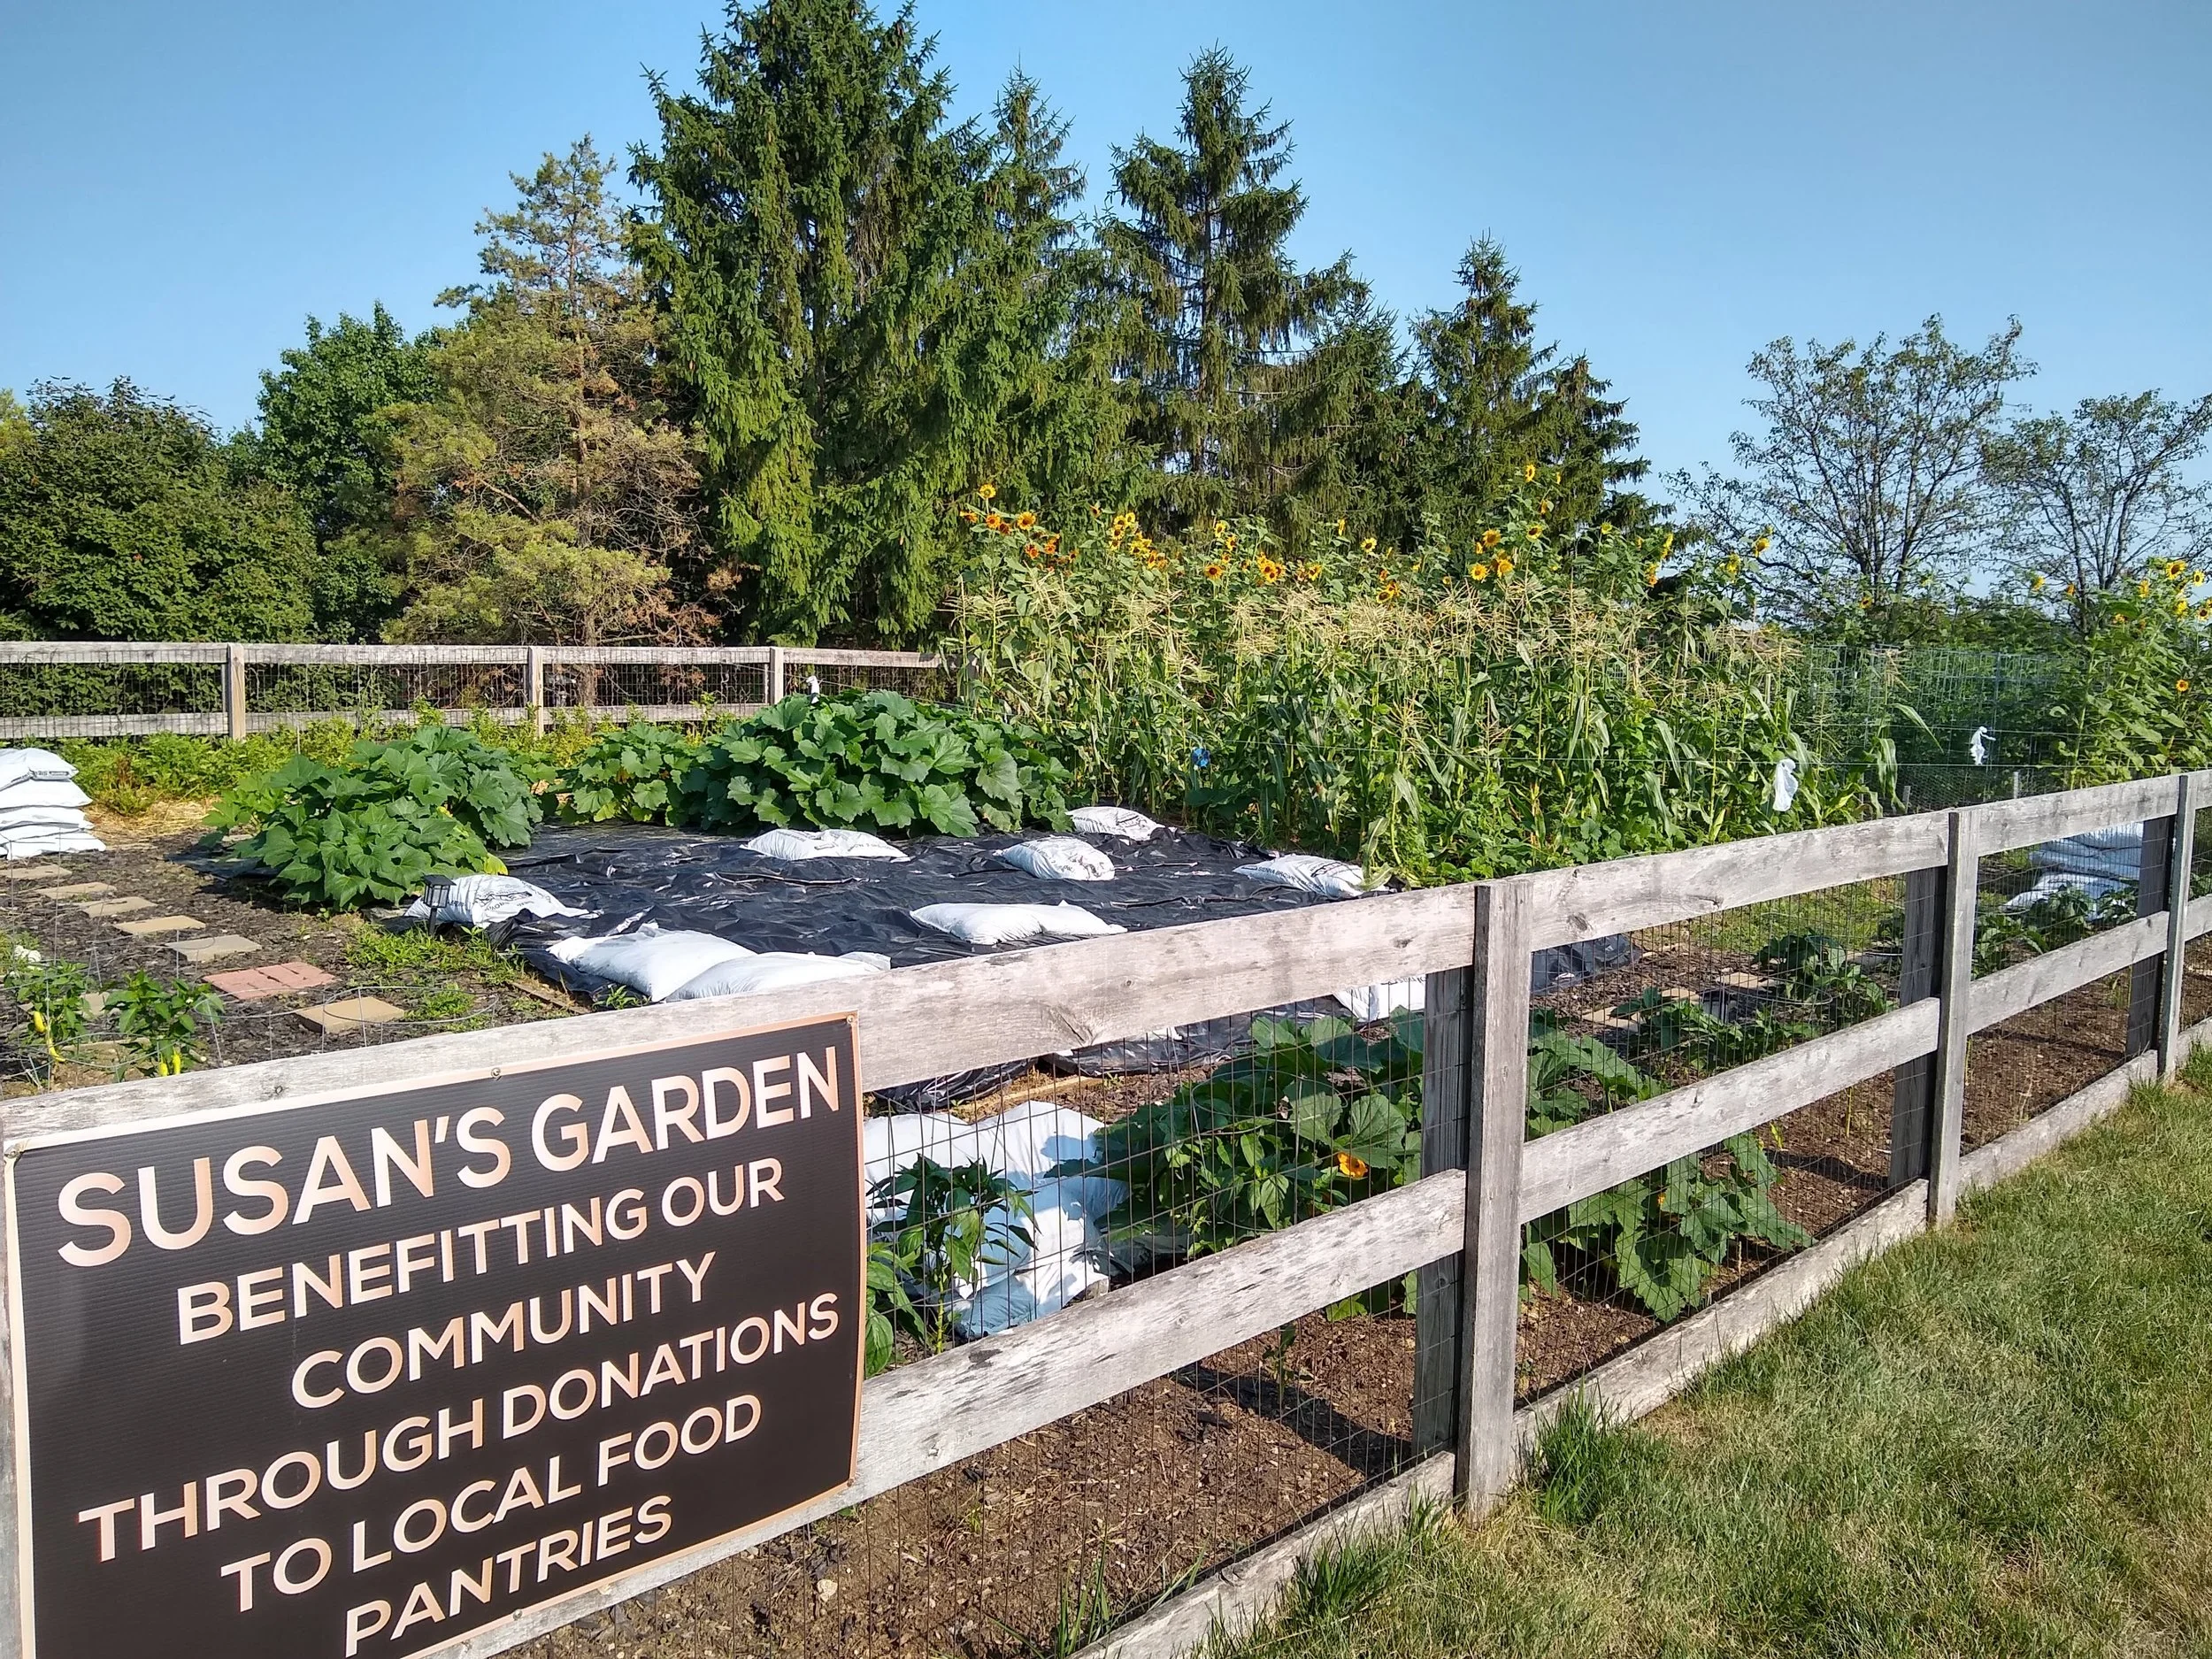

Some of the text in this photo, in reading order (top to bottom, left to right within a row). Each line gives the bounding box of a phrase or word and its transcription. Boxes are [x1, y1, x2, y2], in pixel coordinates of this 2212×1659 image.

[58, 1048, 839, 1266] SUSAN'S GARDEN
[177, 1157, 785, 1345] BENEFITTING OUR
[78, 1293, 839, 1562] THROUGH DONATIONS
[292, 1251, 716, 1409] COMMUNITY
[221, 1394, 761, 1612] TO LOCAL FOOD
[346, 1495, 672, 1657] PANTRIES
